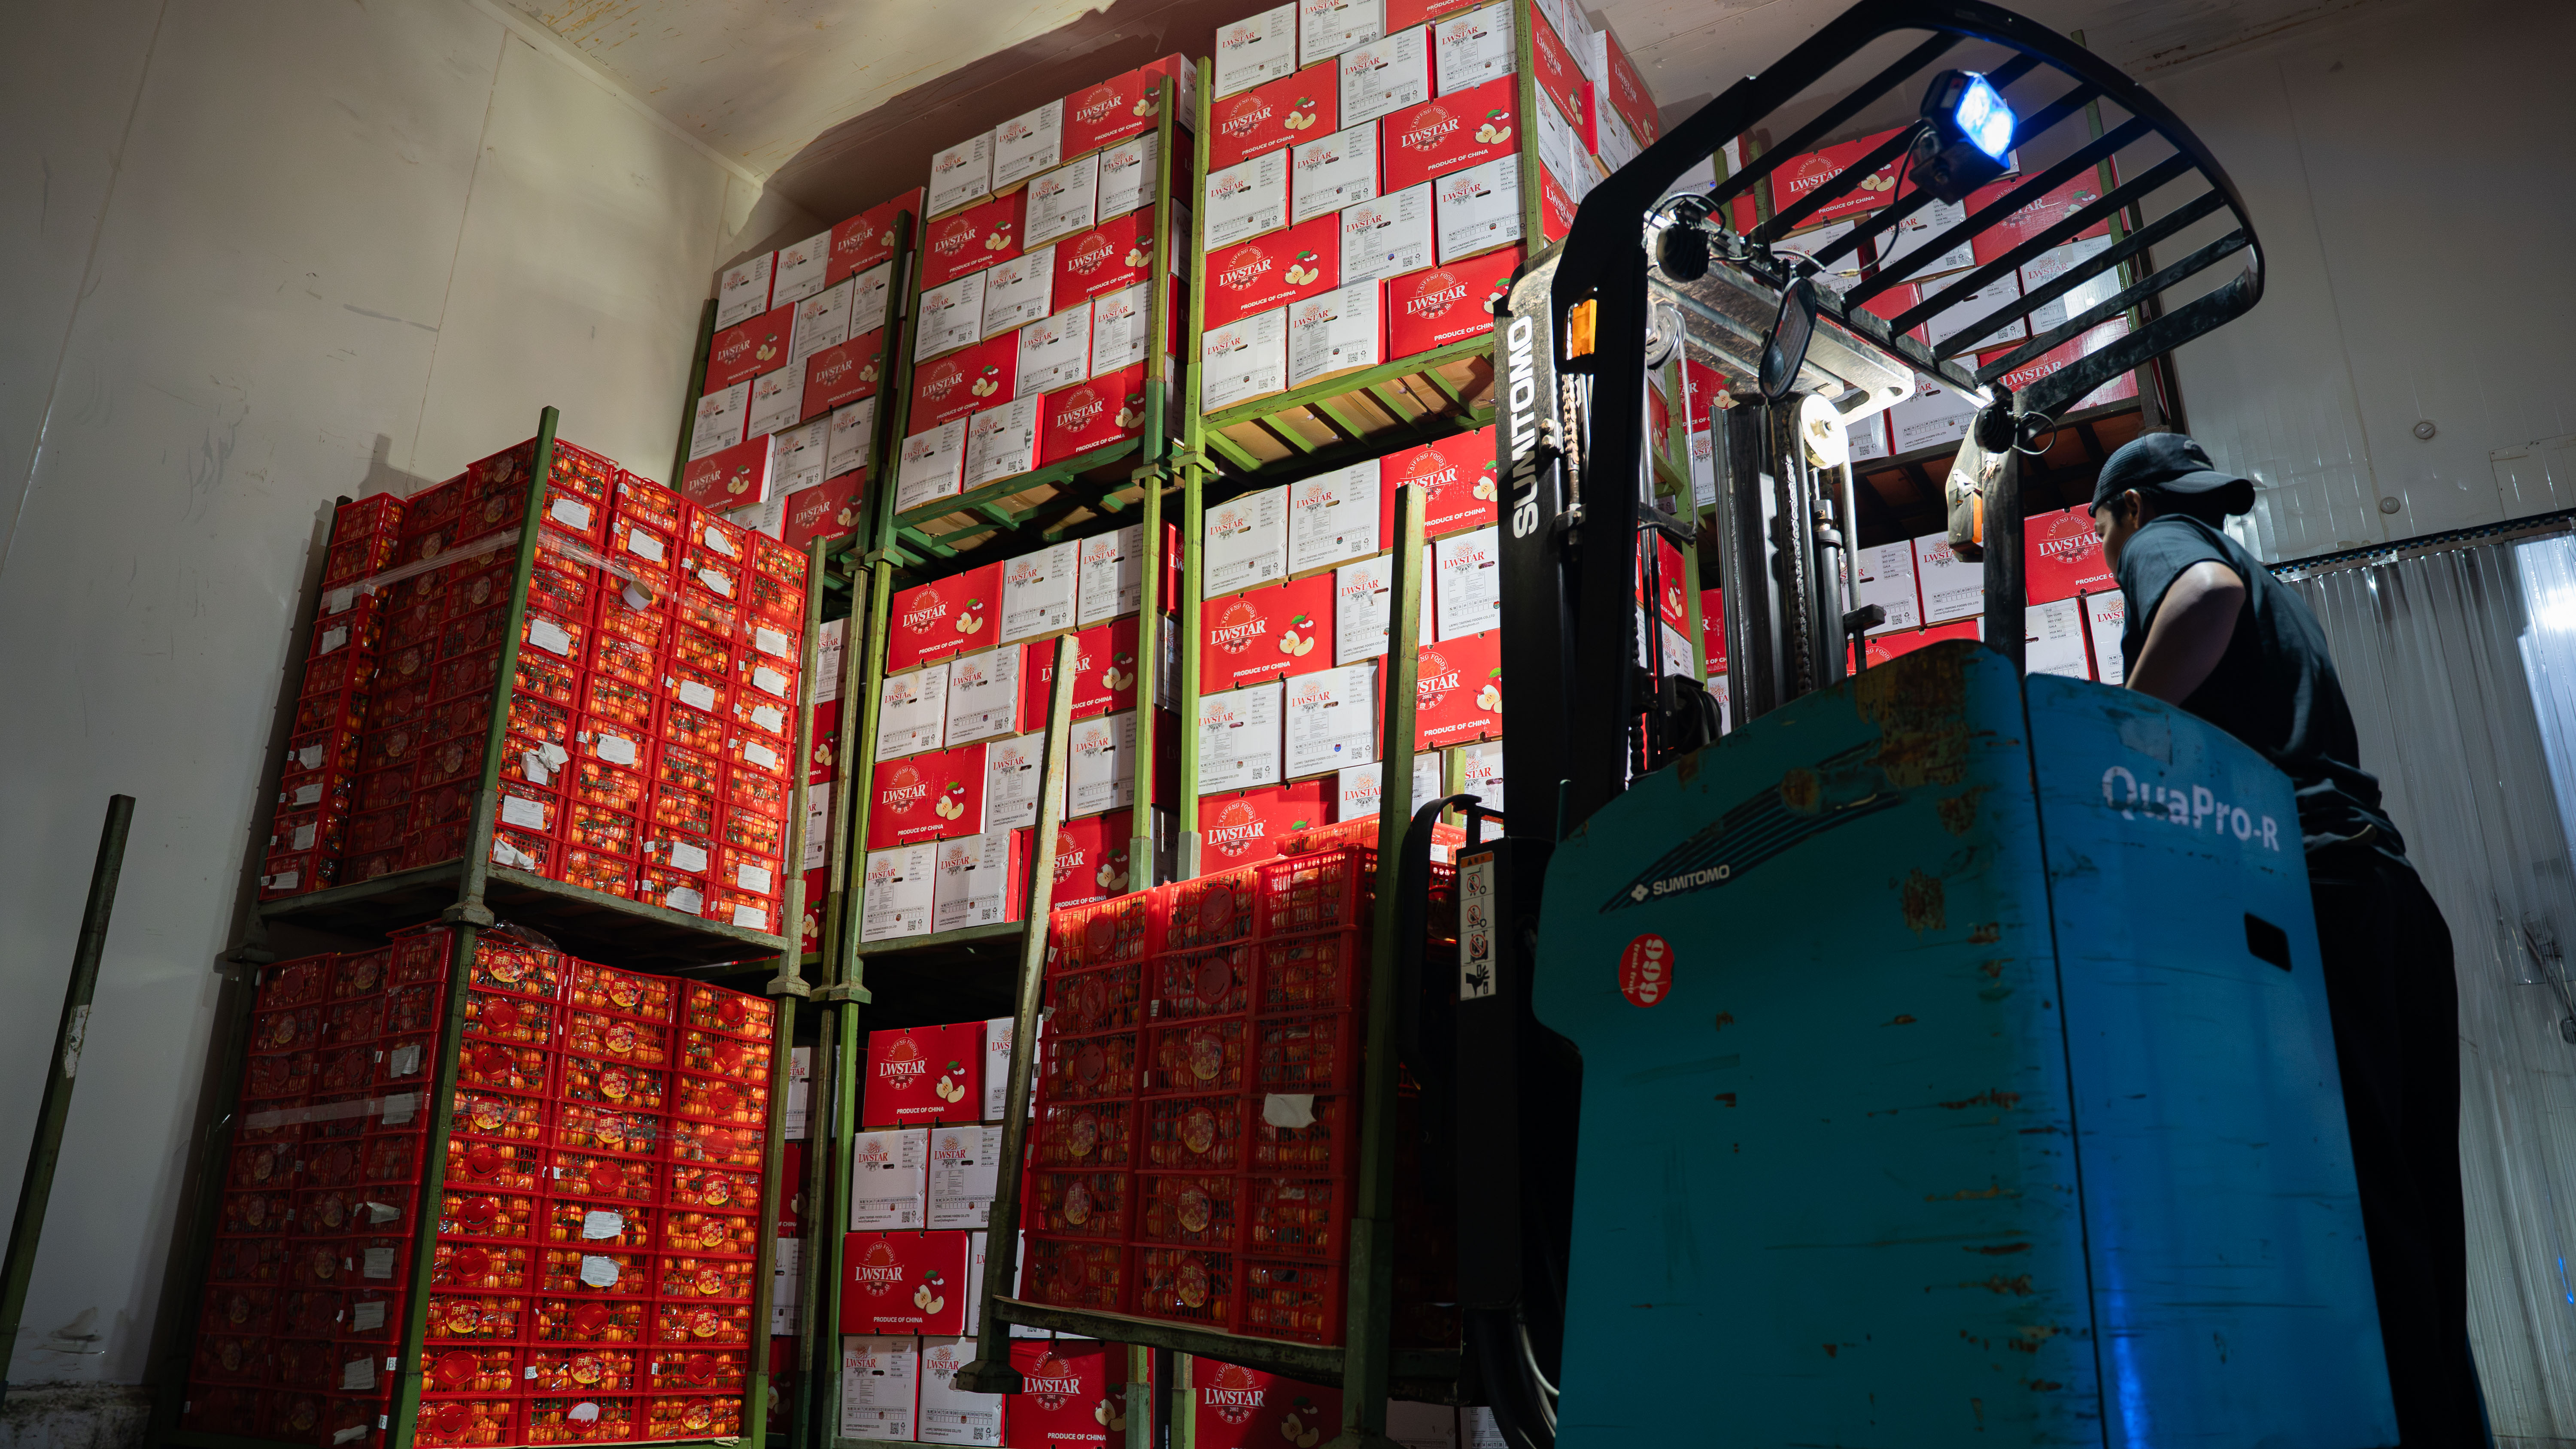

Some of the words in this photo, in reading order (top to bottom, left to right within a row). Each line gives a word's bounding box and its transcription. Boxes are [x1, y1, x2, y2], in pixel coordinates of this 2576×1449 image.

[1222, 32, 1255, 48] LWSTAR
[1442, 27, 1478, 45] LWSTAR
[1345, 57, 1380, 75] LWSTAR
[1076, 96, 1122, 121] LWSTAR
[1221, 107, 1272, 134] LWSTAR
[1412, 108, 1431, 129] TAIFENG
[1433, 107, 1447, 118] FOODS
[999, 126, 1027, 142] LWSTAR
[1402, 118, 1460, 148] LWSTAR
[936, 157, 962, 173] LWSTAR
[1104, 155, 1133, 172] LWSTAR
[1297, 152, 1331, 169] LWSTAR
[1428, 158, 1457, 171] PRODUCE
[1467, 149, 1488, 160] CHINA
[1032, 183, 1059, 200] LWSTAR
[1211, 180, 1243, 197] LWSTAR
[1443, 183, 1480, 203] LWSTAR
[1819, 204, 1846, 214] PRODUCE
[1856, 196, 1874, 204] CHINA
[1346, 215, 1382, 232] LWSTAR
[838, 228, 873, 251] LWSTAR
[935, 229, 975, 253] LWSTAR
[1068, 245, 1113, 272] LWSTAR
[990, 272, 1016, 288] LWSTAR
[1219, 259, 1272, 286] LWSTAR
[1086, 280, 1109, 293] PRODUCE
[1118, 272, 1134, 282] CHINA
[1418, 273, 1438, 294] TAIFENG
[1440, 273, 1455, 285] FOODS
[923, 297, 948, 313] LWSTAR
[1241, 298, 1267, 310] PRODUCE
[1276, 290, 1296, 299] CHINA
[1407, 285, 1467, 314] LWSTAR
[1098, 306, 1128, 323] LWSTAR
[1294, 310, 1328, 328] LWSTAR
[1024, 332, 1051, 348] LWSTAR
[1434, 329, 1465, 341] PRODUCE
[718, 340, 750, 361] LWSTAR
[1207, 337, 1240, 355] LWSTAR
[816, 361, 852, 382] LWSTAR
[922, 373, 962, 397] LWSTAR
[1057, 401, 1103, 427] LWSTAR
[971, 422, 997, 439] LWSTAR
[1508, 315, 1538, 539] SUMITOMO
[904, 445, 929, 461] LWSTAR
[1408, 453, 1427, 475] TAIFENG
[1430, 452, 1445, 467] FOODS
[689, 470, 720, 491] LWSTAR
[1296, 492, 1332, 509] LWSTAR
[796, 502, 830, 524] LWSTAR
[1424, 515, 1453, 526] PRODUCE
[1465, 507, 1485, 518] CHINA
[1210, 518, 1243, 535] LWSTAR
[2049, 517, 2068, 537] TAIFENG
[2071, 516, 2088, 530] FOODS
[1084, 549, 1116, 565] LWSTAR
[1444, 551, 1485, 570] LWSTAR
[1008, 569, 1036, 584] LWSTAR
[1341, 579, 1378, 597] LWSTAR
[903, 605, 946, 627] LWSTAR
[1222, 603, 1242, 624] TAIFENG
[1243, 602, 1256, 618] FOODS
[1211, 619, 1266, 646] LWSTAR
[1233, 667, 1261, 677] PRODUCE
[1271, 661, 1291, 670] CHINA
[954, 672, 981, 686] LWSTAR
[1292, 691, 1330, 707] LWSTAR
[1424, 727, 1455, 737] PRODUCE
[1467, 719, 1490, 728] CHINA
[1076, 737, 1108, 752] LWSTAR
[993, 756, 1024, 770] LWSTAR
[1465, 767, 1491, 780] STAR
[882, 784, 926, 804] LWSTAR
[1218, 803, 1239, 824] TAIFENG
[1240, 802, 1254, 819] FOODS
[2102, 766, 2279, 852] QuaPro-R
[897, 828, 919, 836] PRODUCE
[1208, 822, 1264, 846] LWSTAR
[941, 857, 969, 869] LWSTAR
[1054, 852, 1084, 869] STAR
[868, 868, 895, 880] LWSTAR
[1653, 864, 1730, 895] SUMITOMO
[880, 1060, 926, 1078] LWSTAR
[859, 1151, 888, 1163] LWSTAR
[934, 1148, 966, 1160] LWSTAR
[855, 1267, 902, 1281] LWSTAR
[846, 1358, 876, 1368] LWSTAR
[927, 1359, 959, 1370] LWSTAR
[1023, 1378, 1080, 1394] LWSTAR
[1205, 1388, 1265, 1407] LWSTAR
